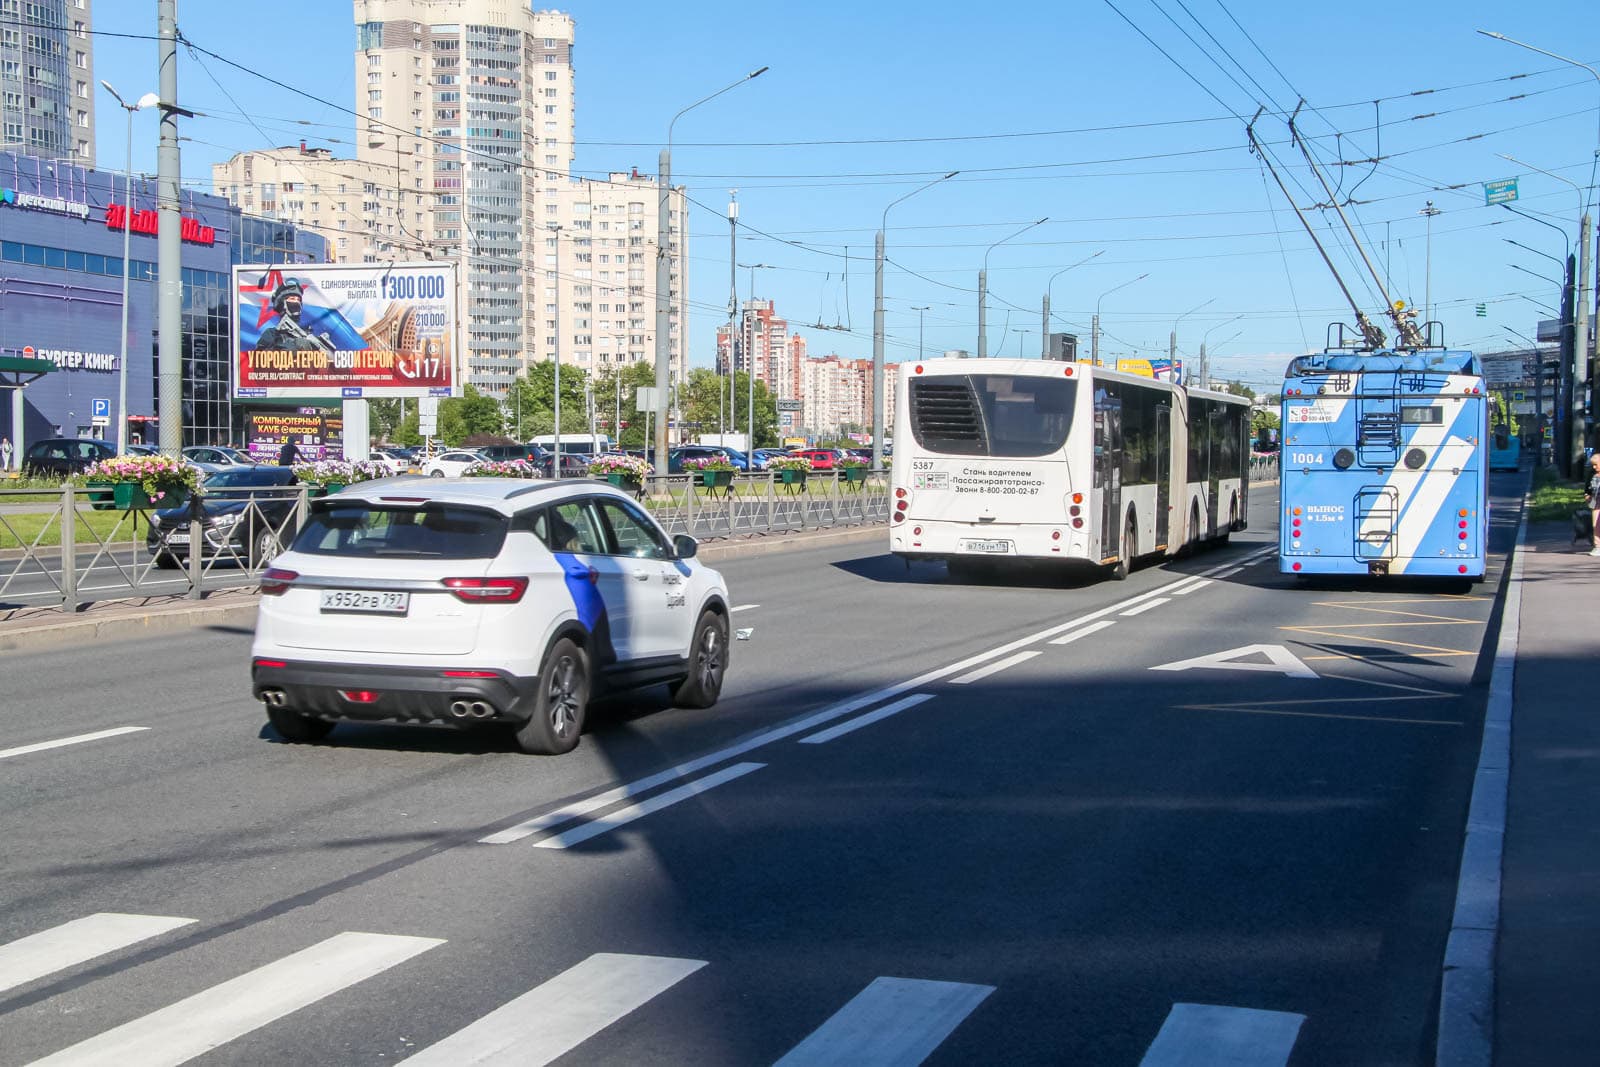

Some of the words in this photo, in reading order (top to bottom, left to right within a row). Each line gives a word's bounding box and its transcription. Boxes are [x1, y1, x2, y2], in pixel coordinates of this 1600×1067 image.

[321, 279, 377, 289] ЕДИНОВРЕМЕННАЯ
[418, 275, 445, 299] 000
[347, 290, 377, 299] ВЫПЛАТА
[38, 349, 82, 367] БУРГЕР
[85, 352, 114, 370] КИНГ
[363, 350, 393, 368] ГЕРОИ
[414, 358, 439, 378] 117
[95, 401, 105, 415] P
[253, 416, 321, 426] КОМПЬЮТЕРНЫЙ
[258, 425, 280, 434] КЛУБ
[1292, 453, 1323, 464] 1004
[913, 462, 934, 470] 5387
[963, 468, 986, 476] Стань
[988, 470, 1032, 478] водителем
[955, 486, 978, 494] Звони
[980, 486, 1039, 496] 8-800-200-02-87
